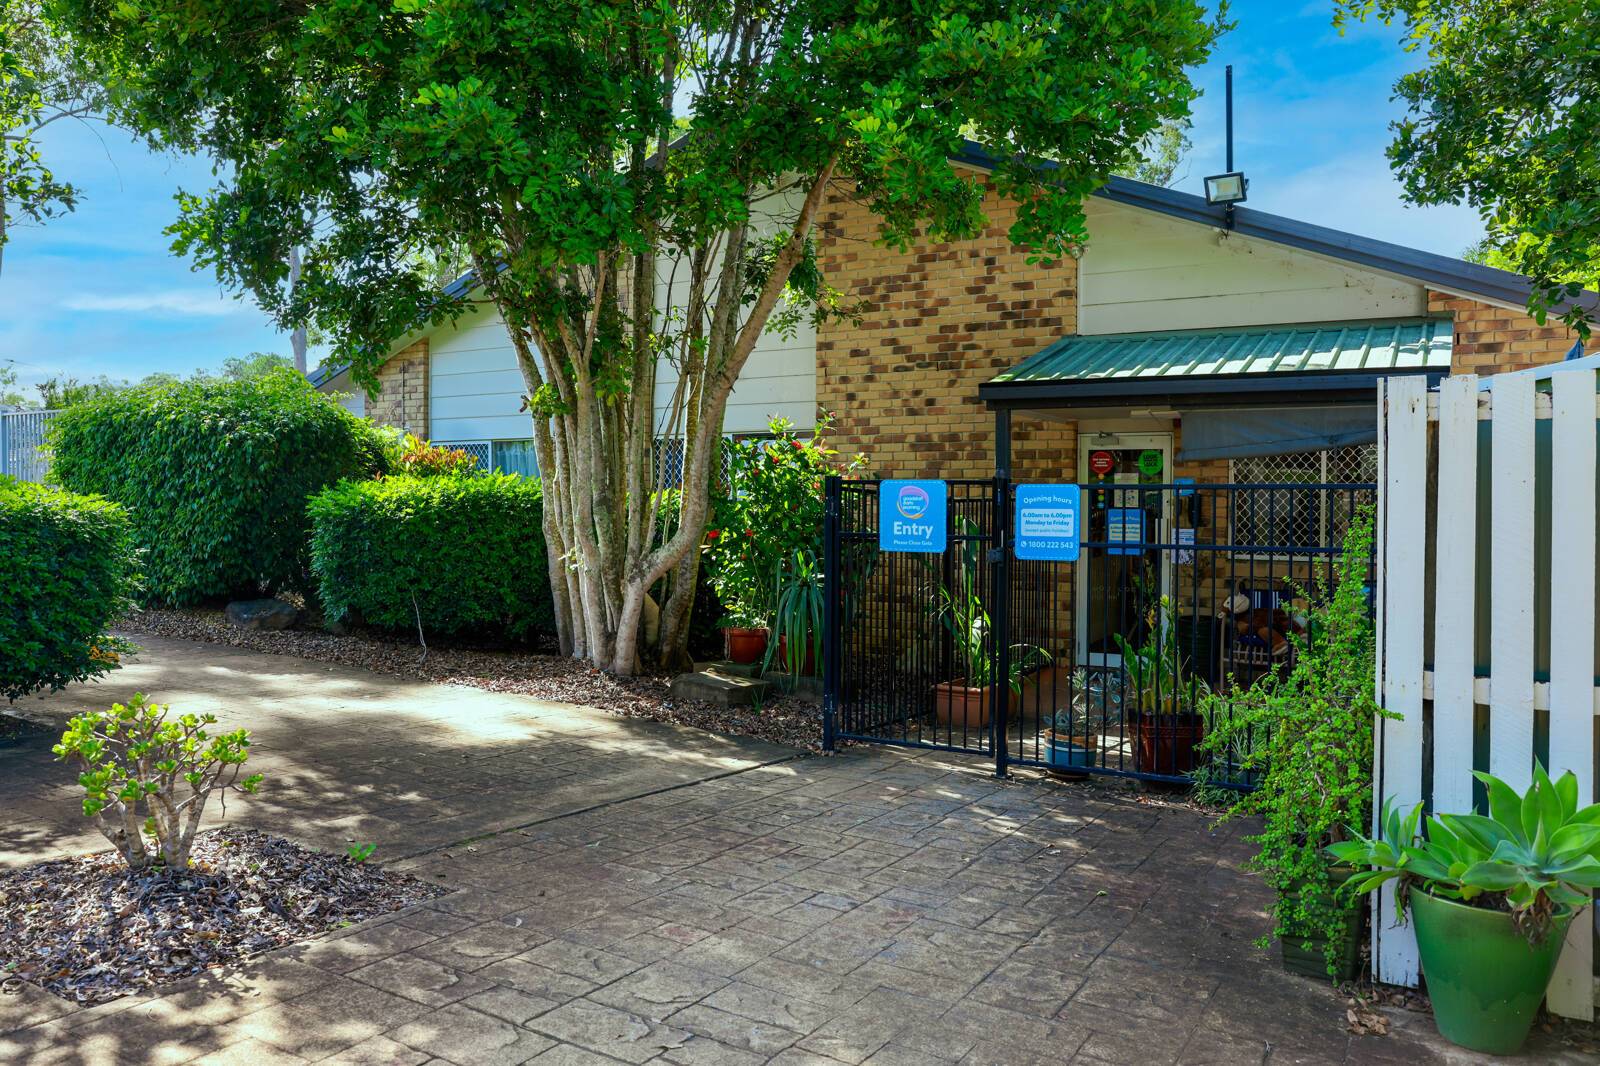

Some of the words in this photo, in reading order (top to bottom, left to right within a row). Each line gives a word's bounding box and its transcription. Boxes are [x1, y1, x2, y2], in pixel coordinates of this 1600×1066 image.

[1023, 495, 1052, 505] Opening
[1053, 495, 1073, 505] hours
[893, 521, 933, 539] Entry
[1029, 540, 1046, 548] 1800
[1046, 541, 1059, 549] 222
[1060, 541, 1074, 549] 543
